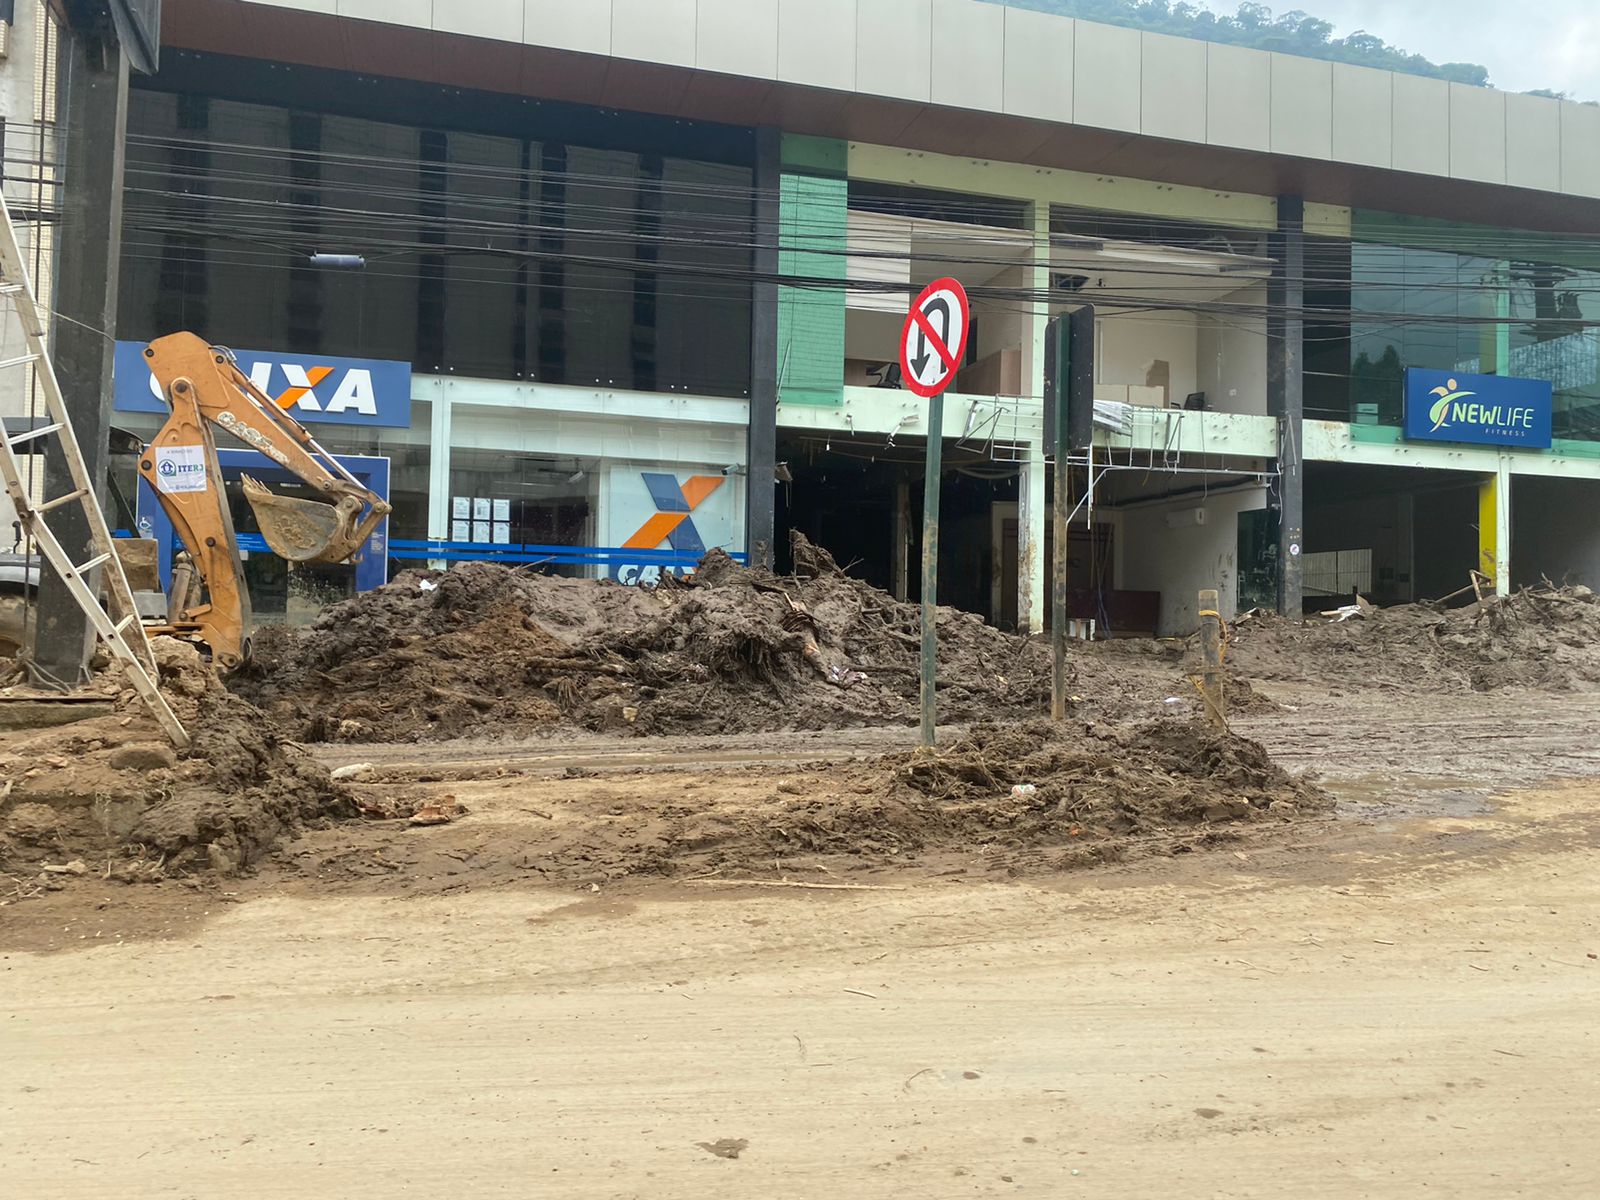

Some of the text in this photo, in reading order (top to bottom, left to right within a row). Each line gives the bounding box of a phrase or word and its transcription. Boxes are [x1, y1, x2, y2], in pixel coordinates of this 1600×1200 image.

[150, 362, 378, 415] IXA
[1452, 402, 1535, 428] NEWLIFE
[1485, 428, 1525, 436] FITNESS
[178, 464, 203, 472] ITERJ
